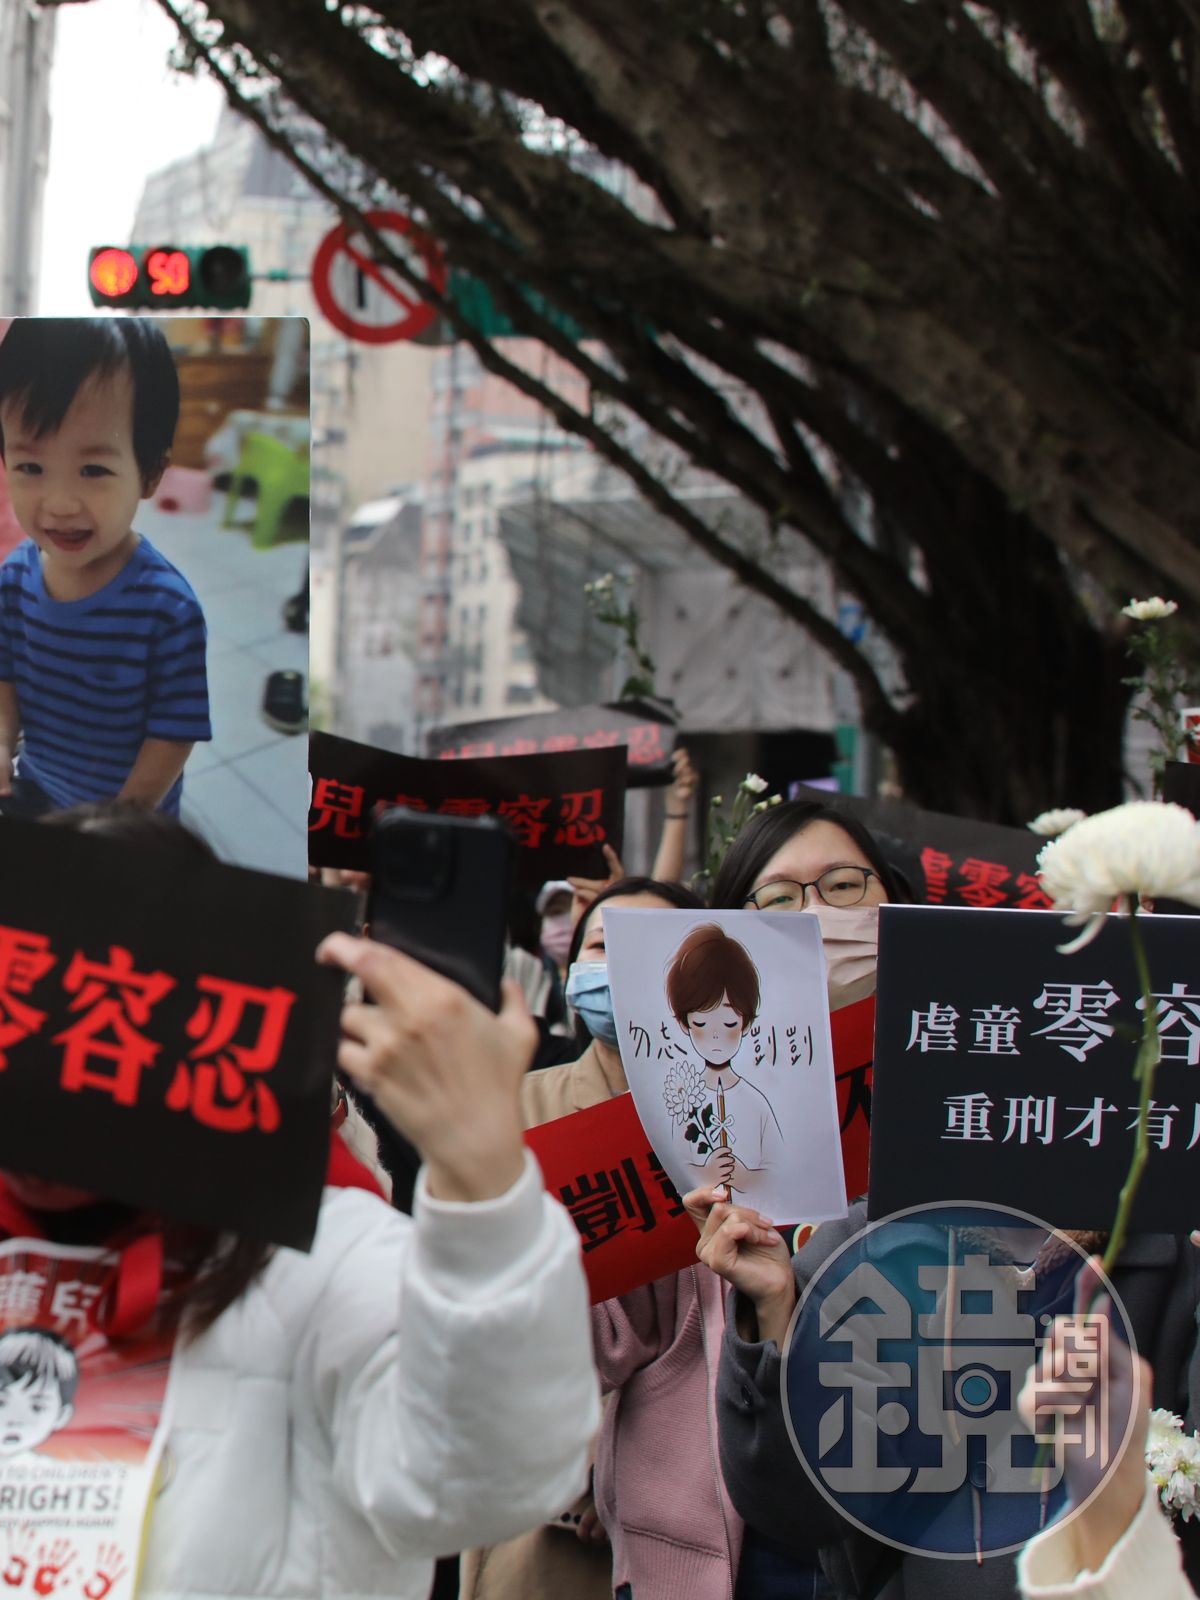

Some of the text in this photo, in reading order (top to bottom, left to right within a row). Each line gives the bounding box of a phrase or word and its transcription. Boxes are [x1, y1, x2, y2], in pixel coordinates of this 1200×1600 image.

[629, 1020, 688, 1060] 勿忘
[940, 1092, 1200, 1151] 重刑才有
